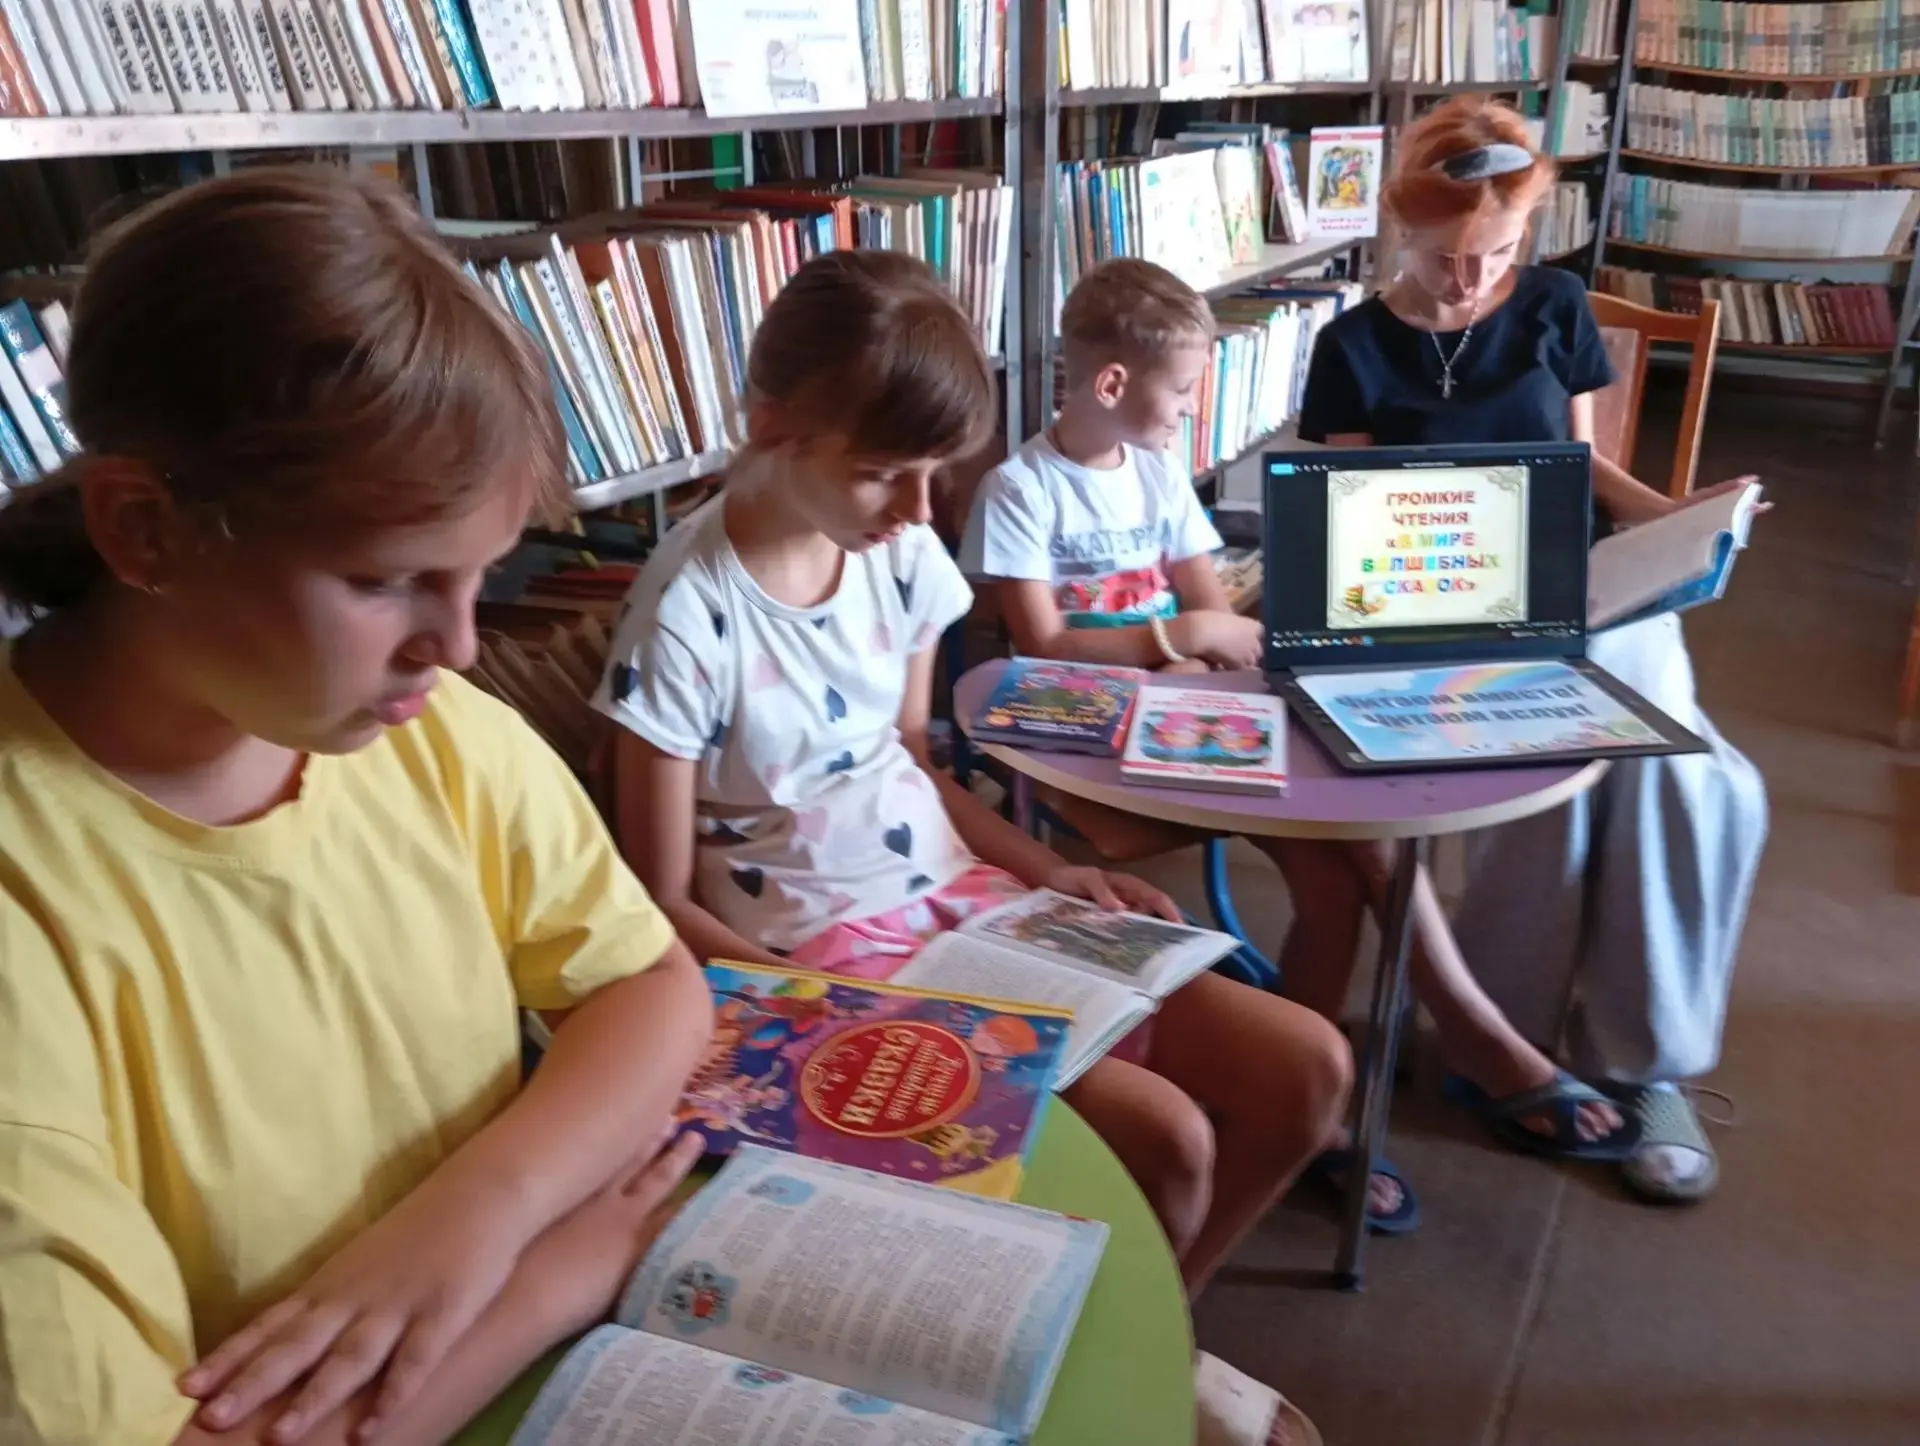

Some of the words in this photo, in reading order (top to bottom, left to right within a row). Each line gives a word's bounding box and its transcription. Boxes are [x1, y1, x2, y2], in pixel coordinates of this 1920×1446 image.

[1386, 490, 1476, 506] ГРОМКИЕ
[1392, 511, 1469, 526] ЧТЕНИЯ
[1418, 532, 1476, 547] МИРЕ
[1334, 693, 1457, 710] Читаем
[1362, 709, 1490, 729] Читаем
[839, 1027, 919, 1125] СКАЗКИ
